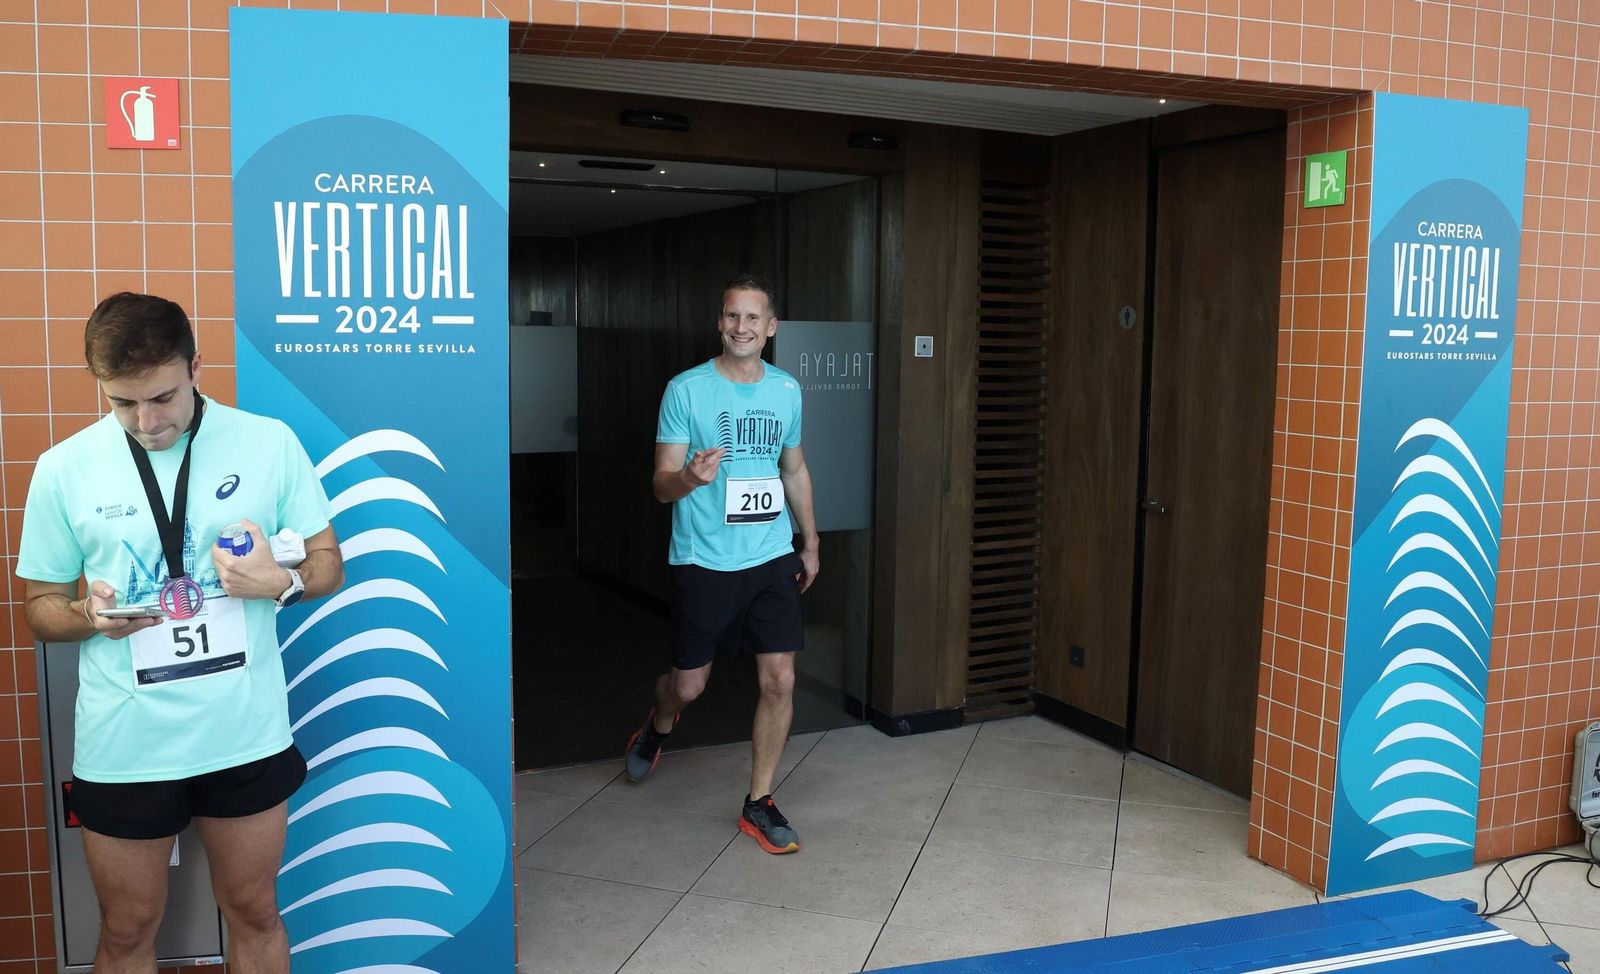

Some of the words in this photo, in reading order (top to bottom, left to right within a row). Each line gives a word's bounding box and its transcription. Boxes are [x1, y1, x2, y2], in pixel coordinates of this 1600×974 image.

[314, 173, 434, 194] CARRERA
[1417, 221, 1483, 240] CARRERA
[273, 201, 475, 300] VERTICAL
[1394, 242, 1500, 320] VERTICAL
[335, 305, 421, 334] 2024
[1421, 323, 1469, 345] 2024
[275, 343, 359, 353] EUROSTARS
[366, 344, 412, 353] TORRE
[418, 344, 476, 354] SEVILLA
[1387, 352, 1434, 360] EUROSTARS
[1465, 353, 1497, 361] SEVILLA
[745, 409, 776, 417] CARRERA
[750, 446, 772, 455] 2024
[740, 492, 772, 511] 210
[172, 623, 210, 658] 51
